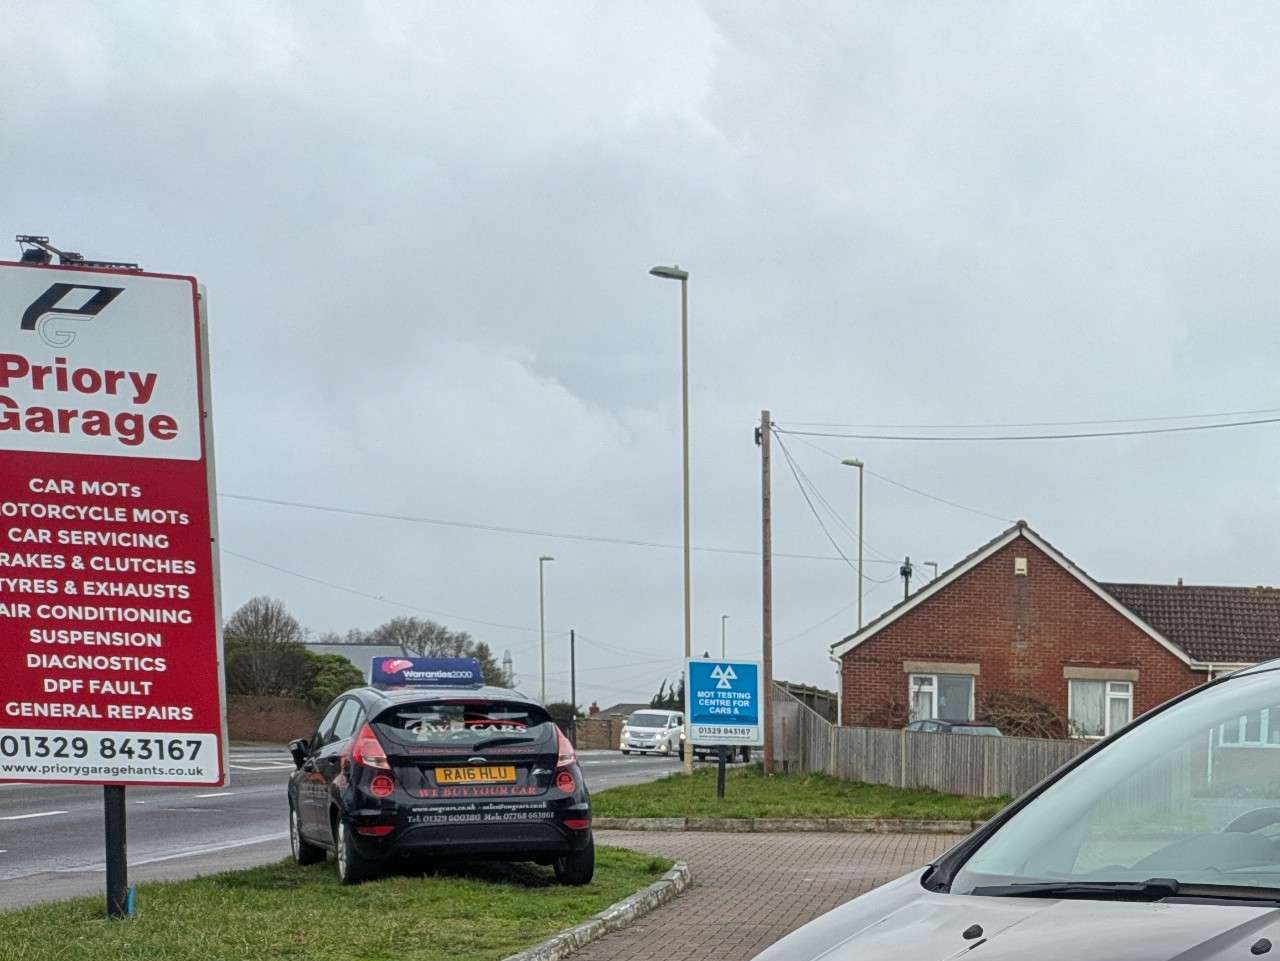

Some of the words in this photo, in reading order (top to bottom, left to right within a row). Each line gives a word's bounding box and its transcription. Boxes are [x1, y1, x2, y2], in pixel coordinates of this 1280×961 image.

[0, 354, 158, 404] Priory
[0, 395, 179, 446] Garage
[29, 478, 76, 495] CAR
[81, 481, 142, 498] MOTs
[0, 502, 127, 523] OTORCYCLE
[133, 508, 190, 525] MOTs
[8, 527, 52, 544] CAR
[58, 530, 169, 549] SERVICING
[0, 552, 65, 570] RAKES
[71, 556, 84, 570] &
[90, 556, 196, 575] CLUTCHES
[64, 580, 77, 595] &
[83, 581, 190, 600] EXHAUSTS
[0, 603, 31, 618] AIR
[37, 604, 192, 624] CONDITIONING
[30, 629, 162, 648] SUSPENSION
[27, 653, 167, 672] DIAGNOSTICS
[402, 670, 473, 679] Warranties2000
[43, 678, 83, 694] DPF
[89, 679, 152, 696] FAULT
[5, 702, 102, 719] GENERAL
[107, 704, 194, 721] REPAIRS
[470, 724, 528, 734] CARS
[1, 735, 88, 759] 01329
[99, 738, 203, 760] 843167
[2, 763, 204, 777] www.priorygaragehants.co.uk
[443, 767, 476, 780] RA16
[480, 766, 508, 780] HLU
[419, 788, 438, 798] WE
[443, 787, 469, 797] BUY
[472, 786, 509, 796] YOUR
[511, 786, 537, 796] CAR
